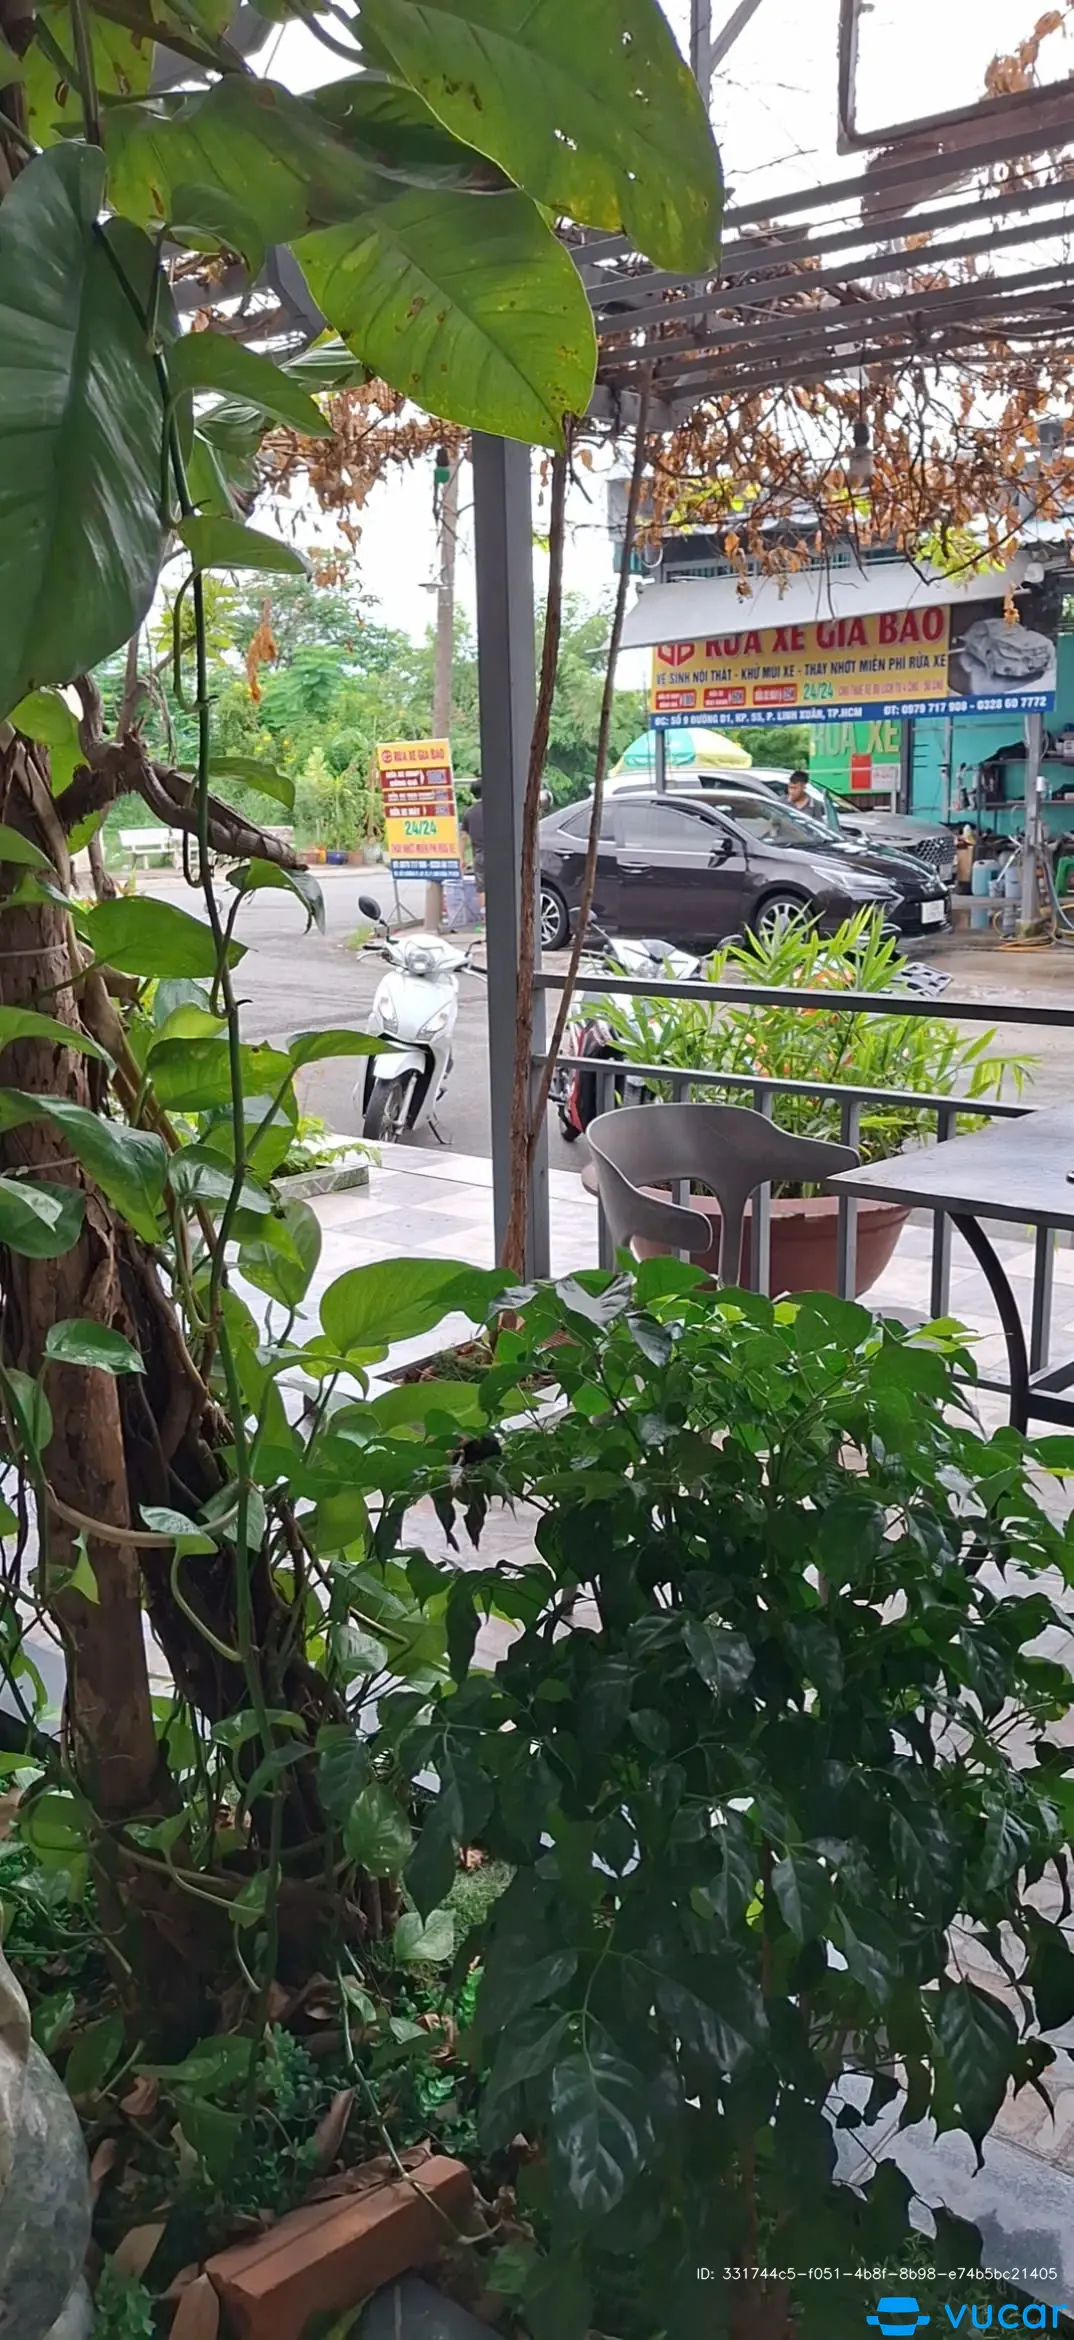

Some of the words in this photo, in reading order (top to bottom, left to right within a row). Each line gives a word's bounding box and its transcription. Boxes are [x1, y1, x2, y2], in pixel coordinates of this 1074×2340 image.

[773, 624, 806, 652] XE
[816, 617, 867, 650] GIA
[669, 671, 690, 685] SINH
[783, 664, 795, 678] XE
[804, 662, 828, 677] THAY
[933, 653, 946, 667] XE
[803, 680, 835, 701] 24/24
[827, 707, 863, 719] TP.HCM
[901, 703, 926, 715] 0979
[928, 702, 946, 714] 717
[1020, 696, 1047, 708] 7772
[404, 820, 437, 836] 24/24
